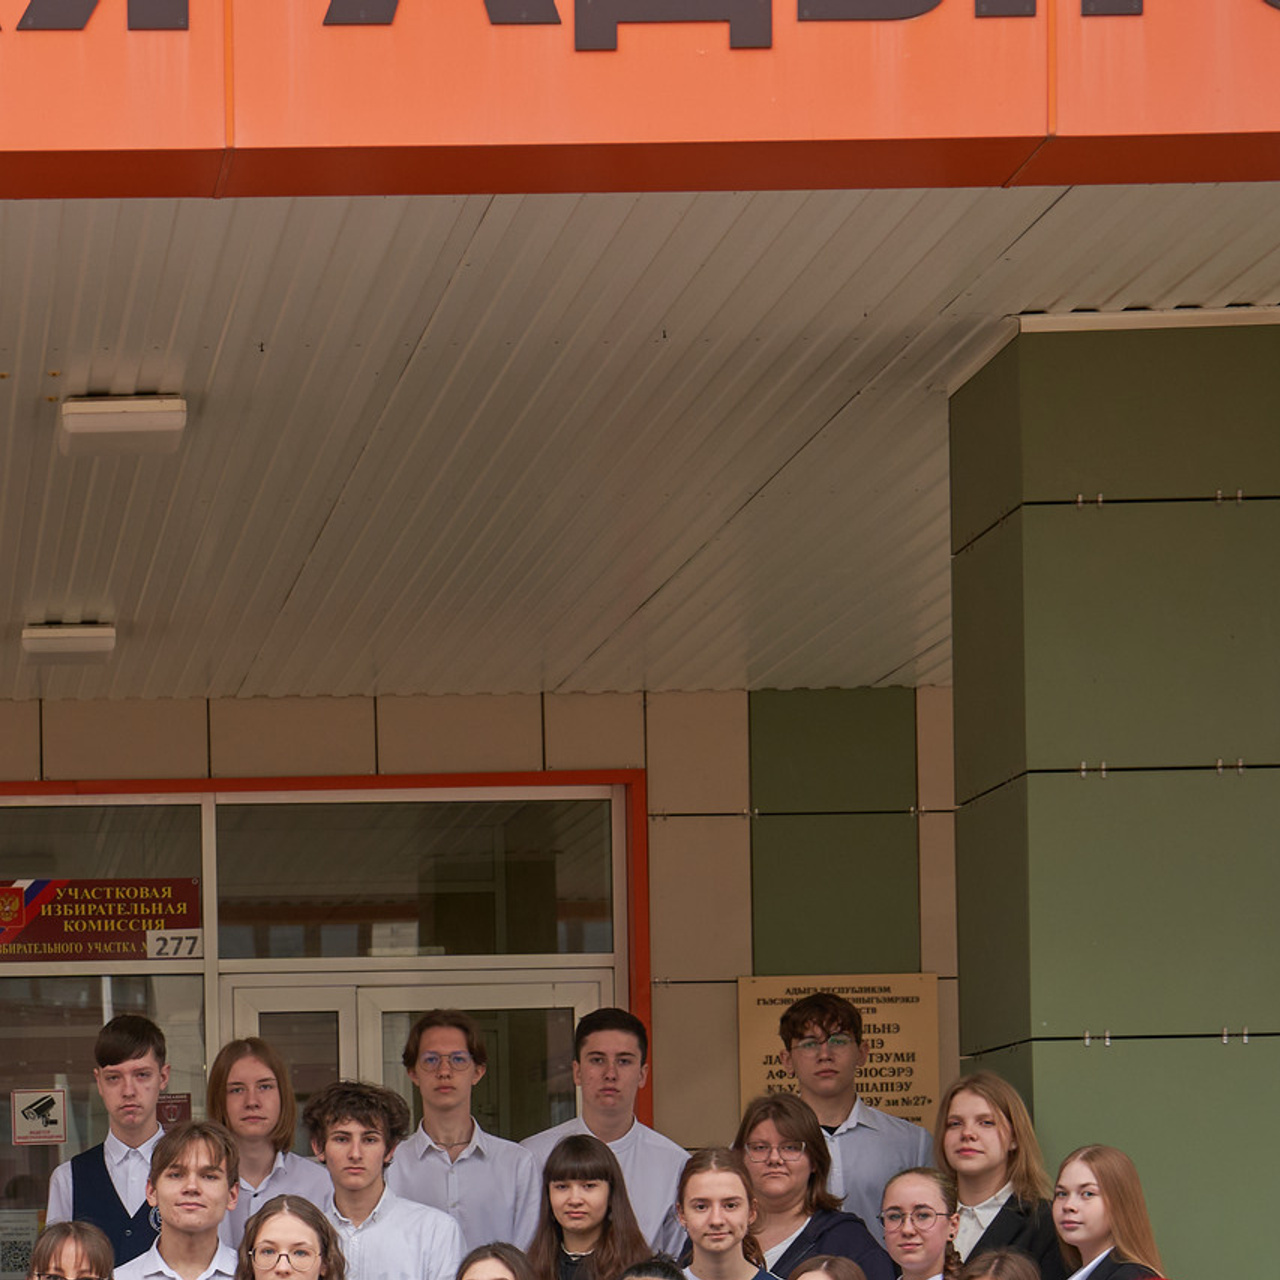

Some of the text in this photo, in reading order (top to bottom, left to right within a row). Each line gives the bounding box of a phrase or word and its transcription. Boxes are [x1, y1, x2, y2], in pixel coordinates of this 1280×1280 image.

[55, 886, 172, 900] УЧАСТКОВАЯ
[40, 902, 187, 917] ИЗБИРАТЕЛЬНАЯ
[63, 918, 166, 933] КОМИССИЯ
[87, 940, 137, 953] УЧАСТКА
[155, 935, 199, 956] 277
